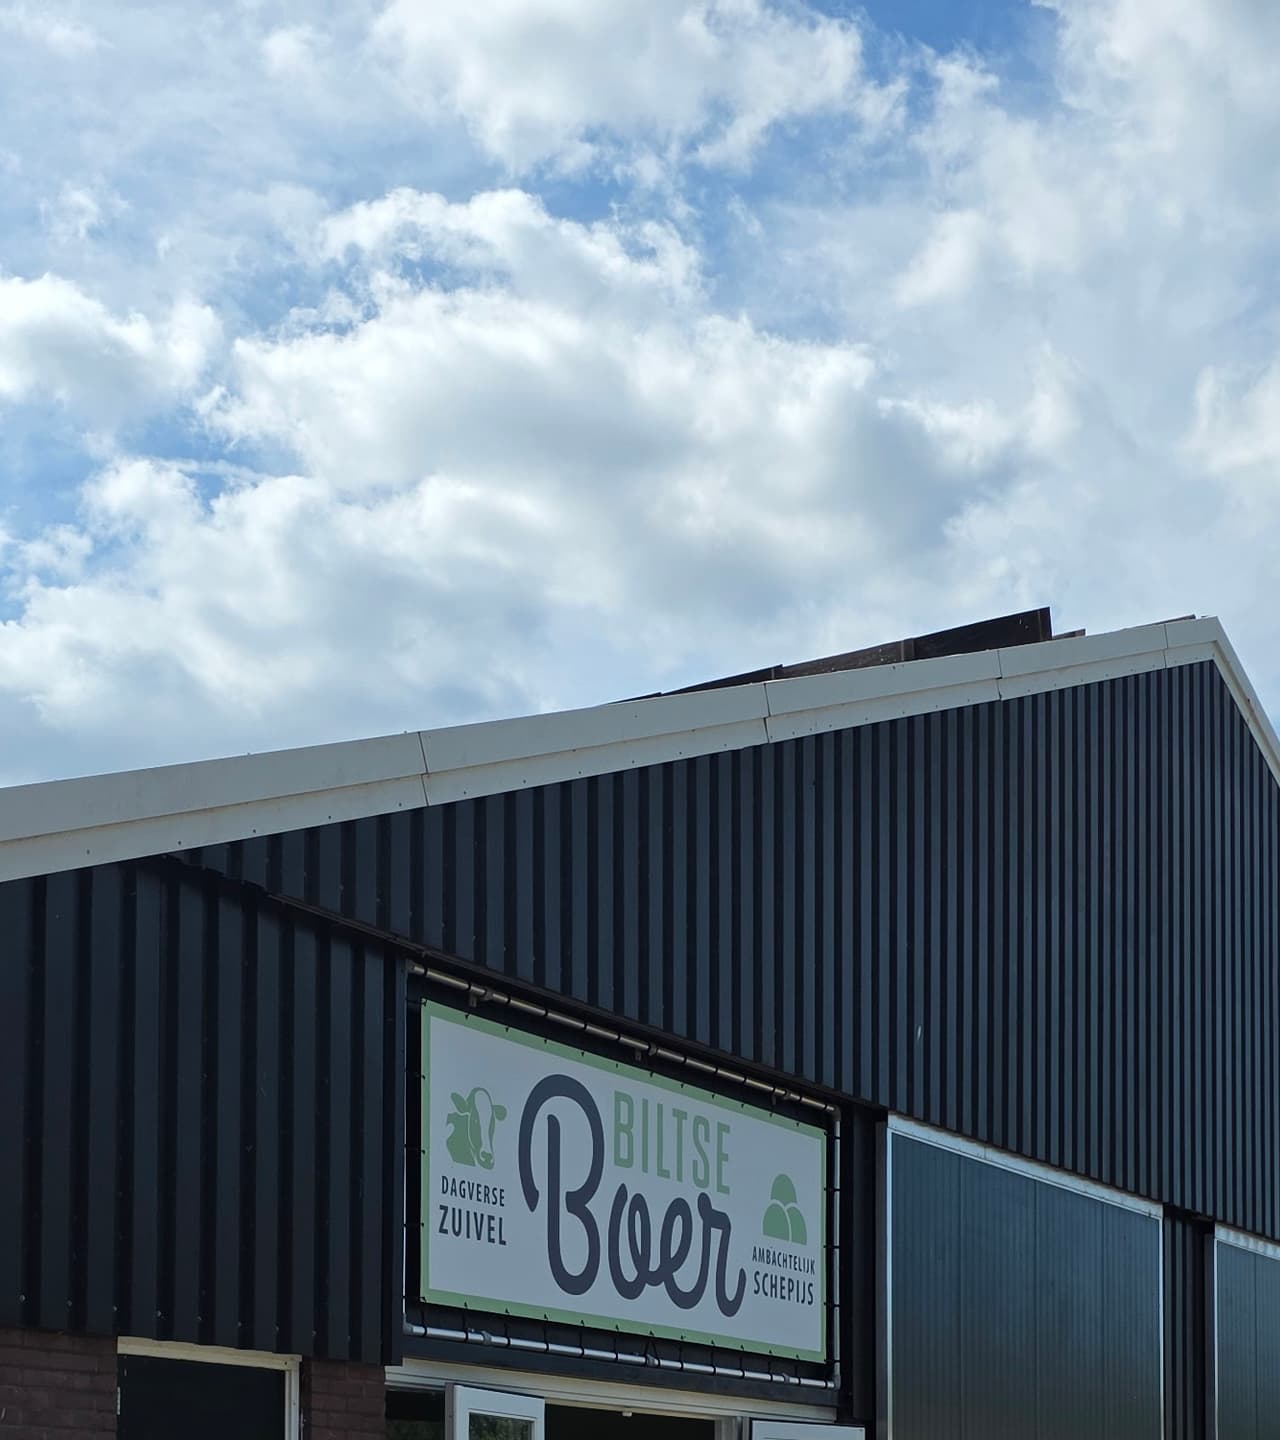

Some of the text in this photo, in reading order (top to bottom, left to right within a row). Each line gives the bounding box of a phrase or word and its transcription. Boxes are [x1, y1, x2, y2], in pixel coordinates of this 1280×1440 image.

[613, 1090, 731, 1195] BILTSE
[441, 1176, 505, 1207] DAGVERSE
[519, 1074, 746, 1317] Boer
[438, 1205, 507, 1246] ZUIVEL
[752, 1246, 815, 1275] AMBACHTELIJK
[753, 1270, 814, 1305] SCHEPIJS
